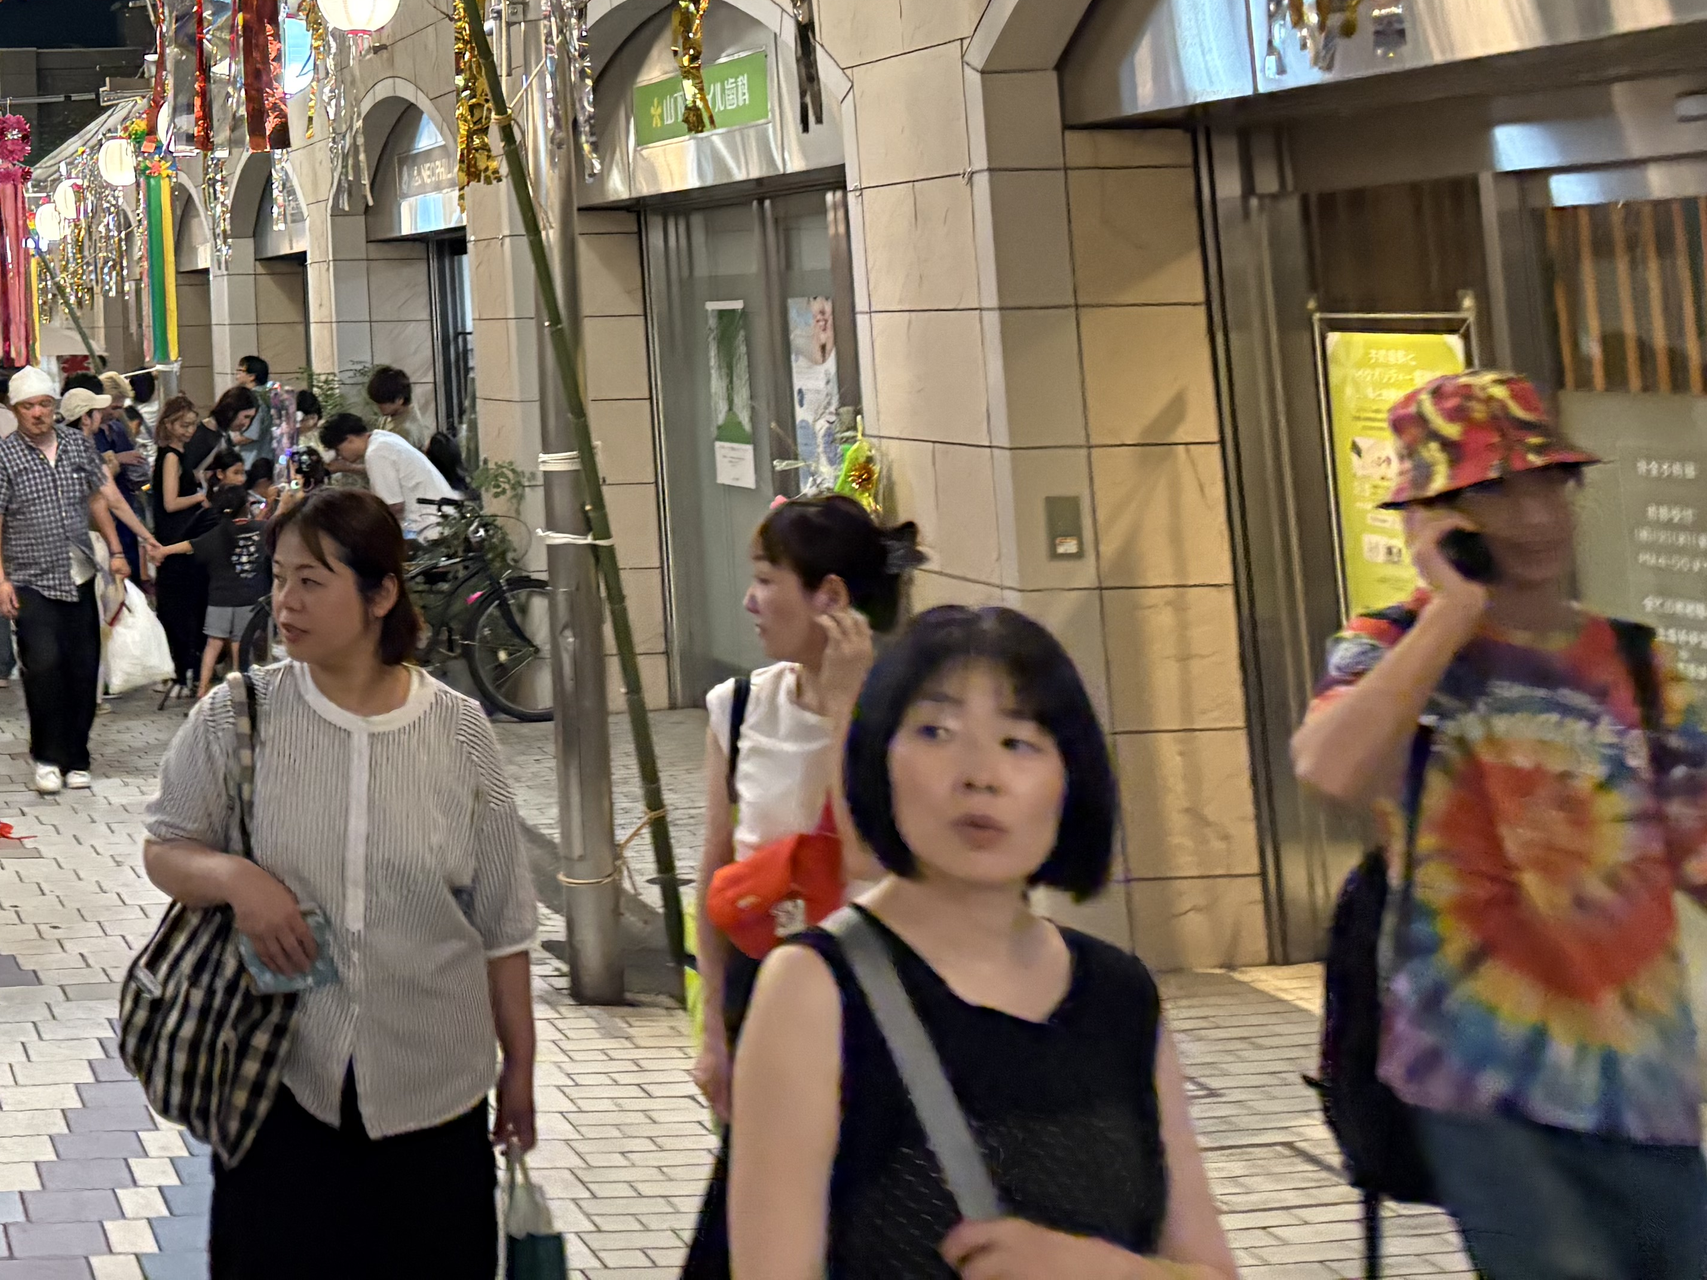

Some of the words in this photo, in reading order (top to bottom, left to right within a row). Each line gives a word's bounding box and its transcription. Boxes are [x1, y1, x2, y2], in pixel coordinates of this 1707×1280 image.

[663, 73, 750, 125] 山下イル歯科
